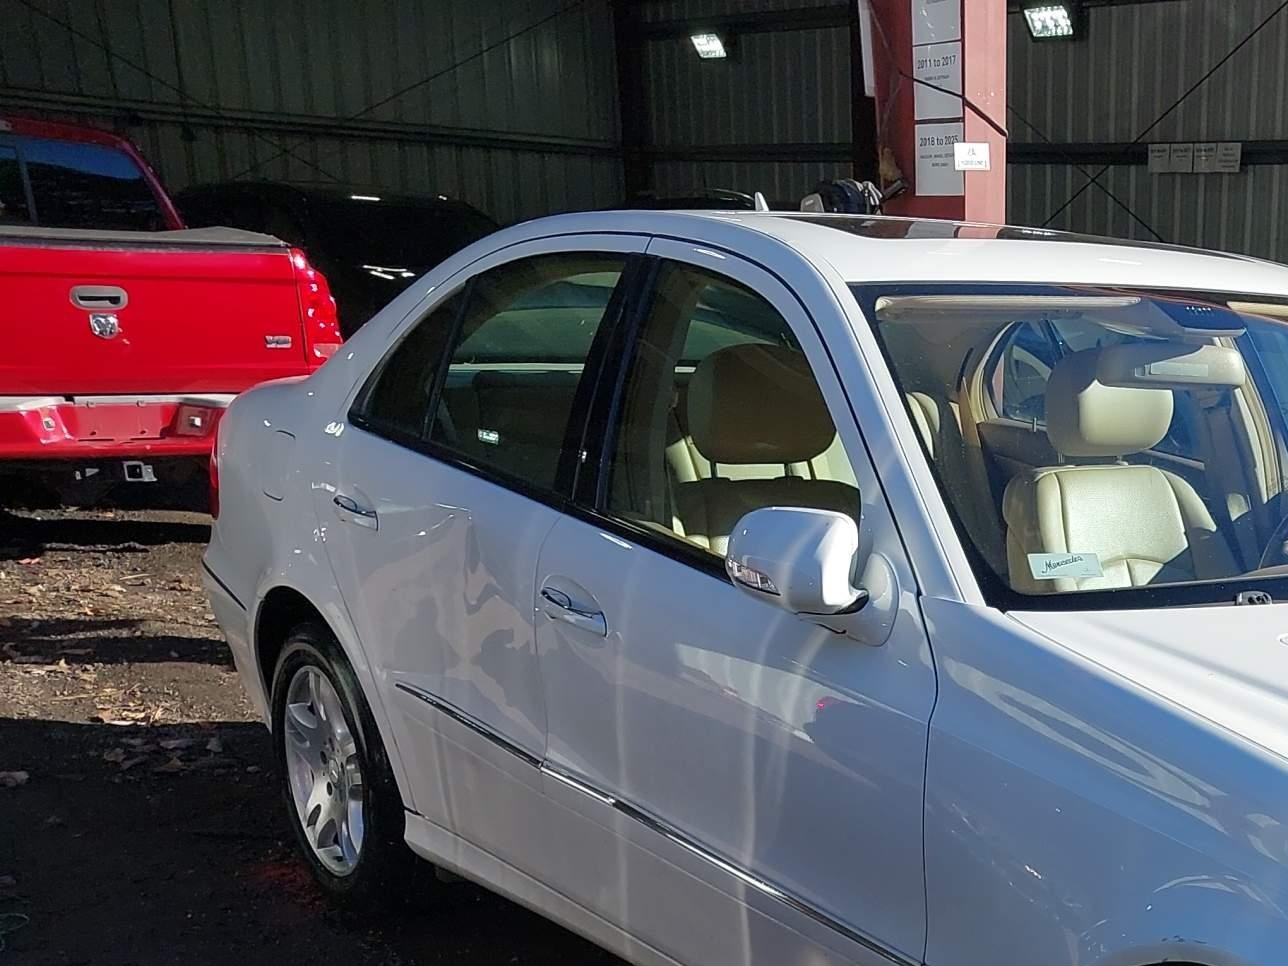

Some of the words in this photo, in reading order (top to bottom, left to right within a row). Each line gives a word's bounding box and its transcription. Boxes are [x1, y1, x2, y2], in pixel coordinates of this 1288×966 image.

[917, 58, 932, 70] 2011
[933, 58, 941, 68] to
[942, 55, 957, 67] 2017
[936, 135, 944, 146] to
